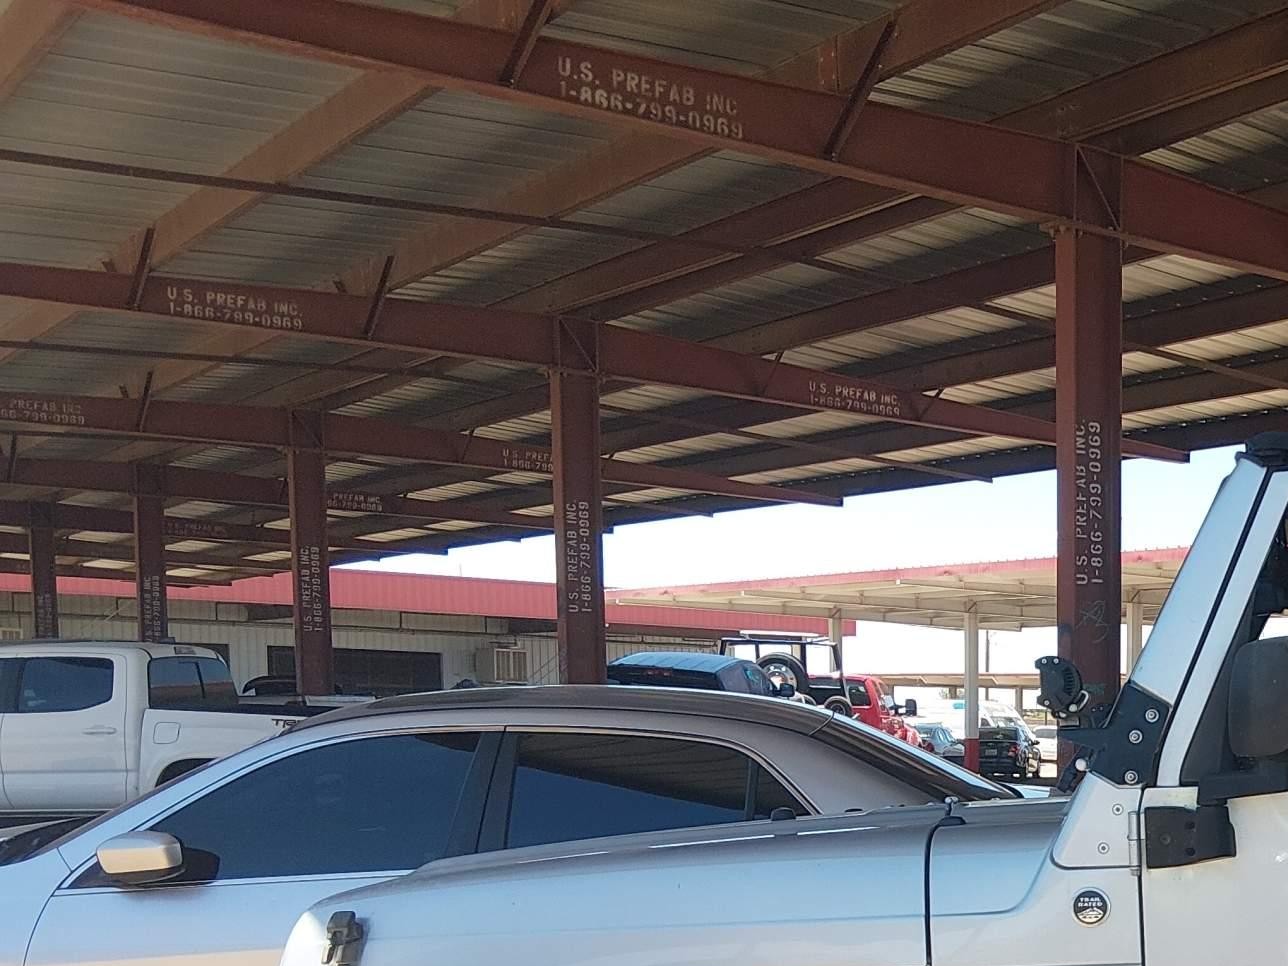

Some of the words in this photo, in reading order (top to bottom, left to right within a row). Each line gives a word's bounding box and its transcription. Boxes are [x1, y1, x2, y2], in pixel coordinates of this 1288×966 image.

[557, 55, 599, 85] U.S.
[611, 68, 695, 106] PREFAB
[206, 291, 267, 311] PREFAB
[835, 385, 877, 402] PREFAB
[1075, 419, 1087, 454] INC.
[1075, 464, 1088, 538] PREFAB
[1088, 421, 1104, 584] 1-866-799-0969
[567, 530, 578, 581] PREFAB
[578, 501, 592, 612] 1-866-799-0969
[1075, 549, 1088, 585] U.S.
[301, 569, 312, 608] PREFAB
